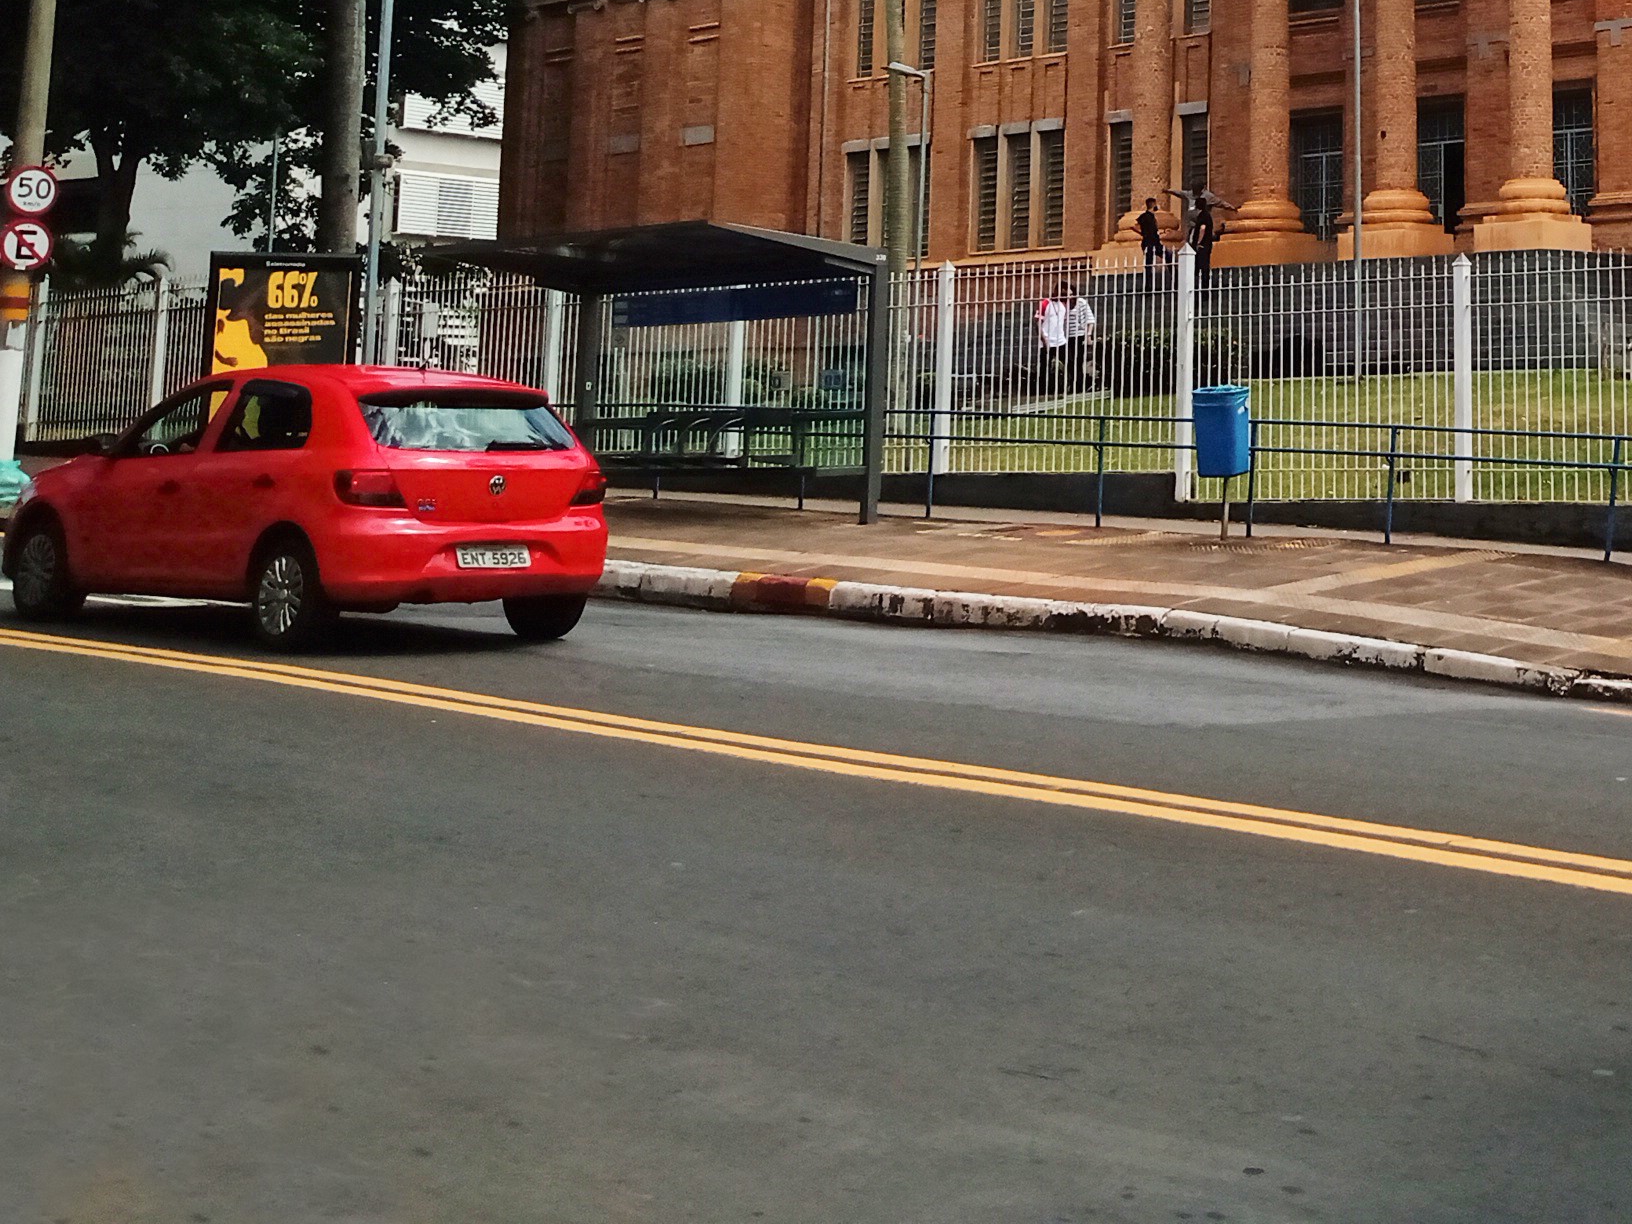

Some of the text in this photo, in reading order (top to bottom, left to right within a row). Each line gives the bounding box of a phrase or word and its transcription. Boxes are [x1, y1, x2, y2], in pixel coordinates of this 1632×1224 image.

[17, 177, 51, 199] 50
[267, 271, 318, 308] 66%
[285, 312, 334, 320] mulheres
[279, 326, 310, 335] Brasil
[285, 335, 322, 343] negras
[461, 553, 527, 566] ENT 5926
